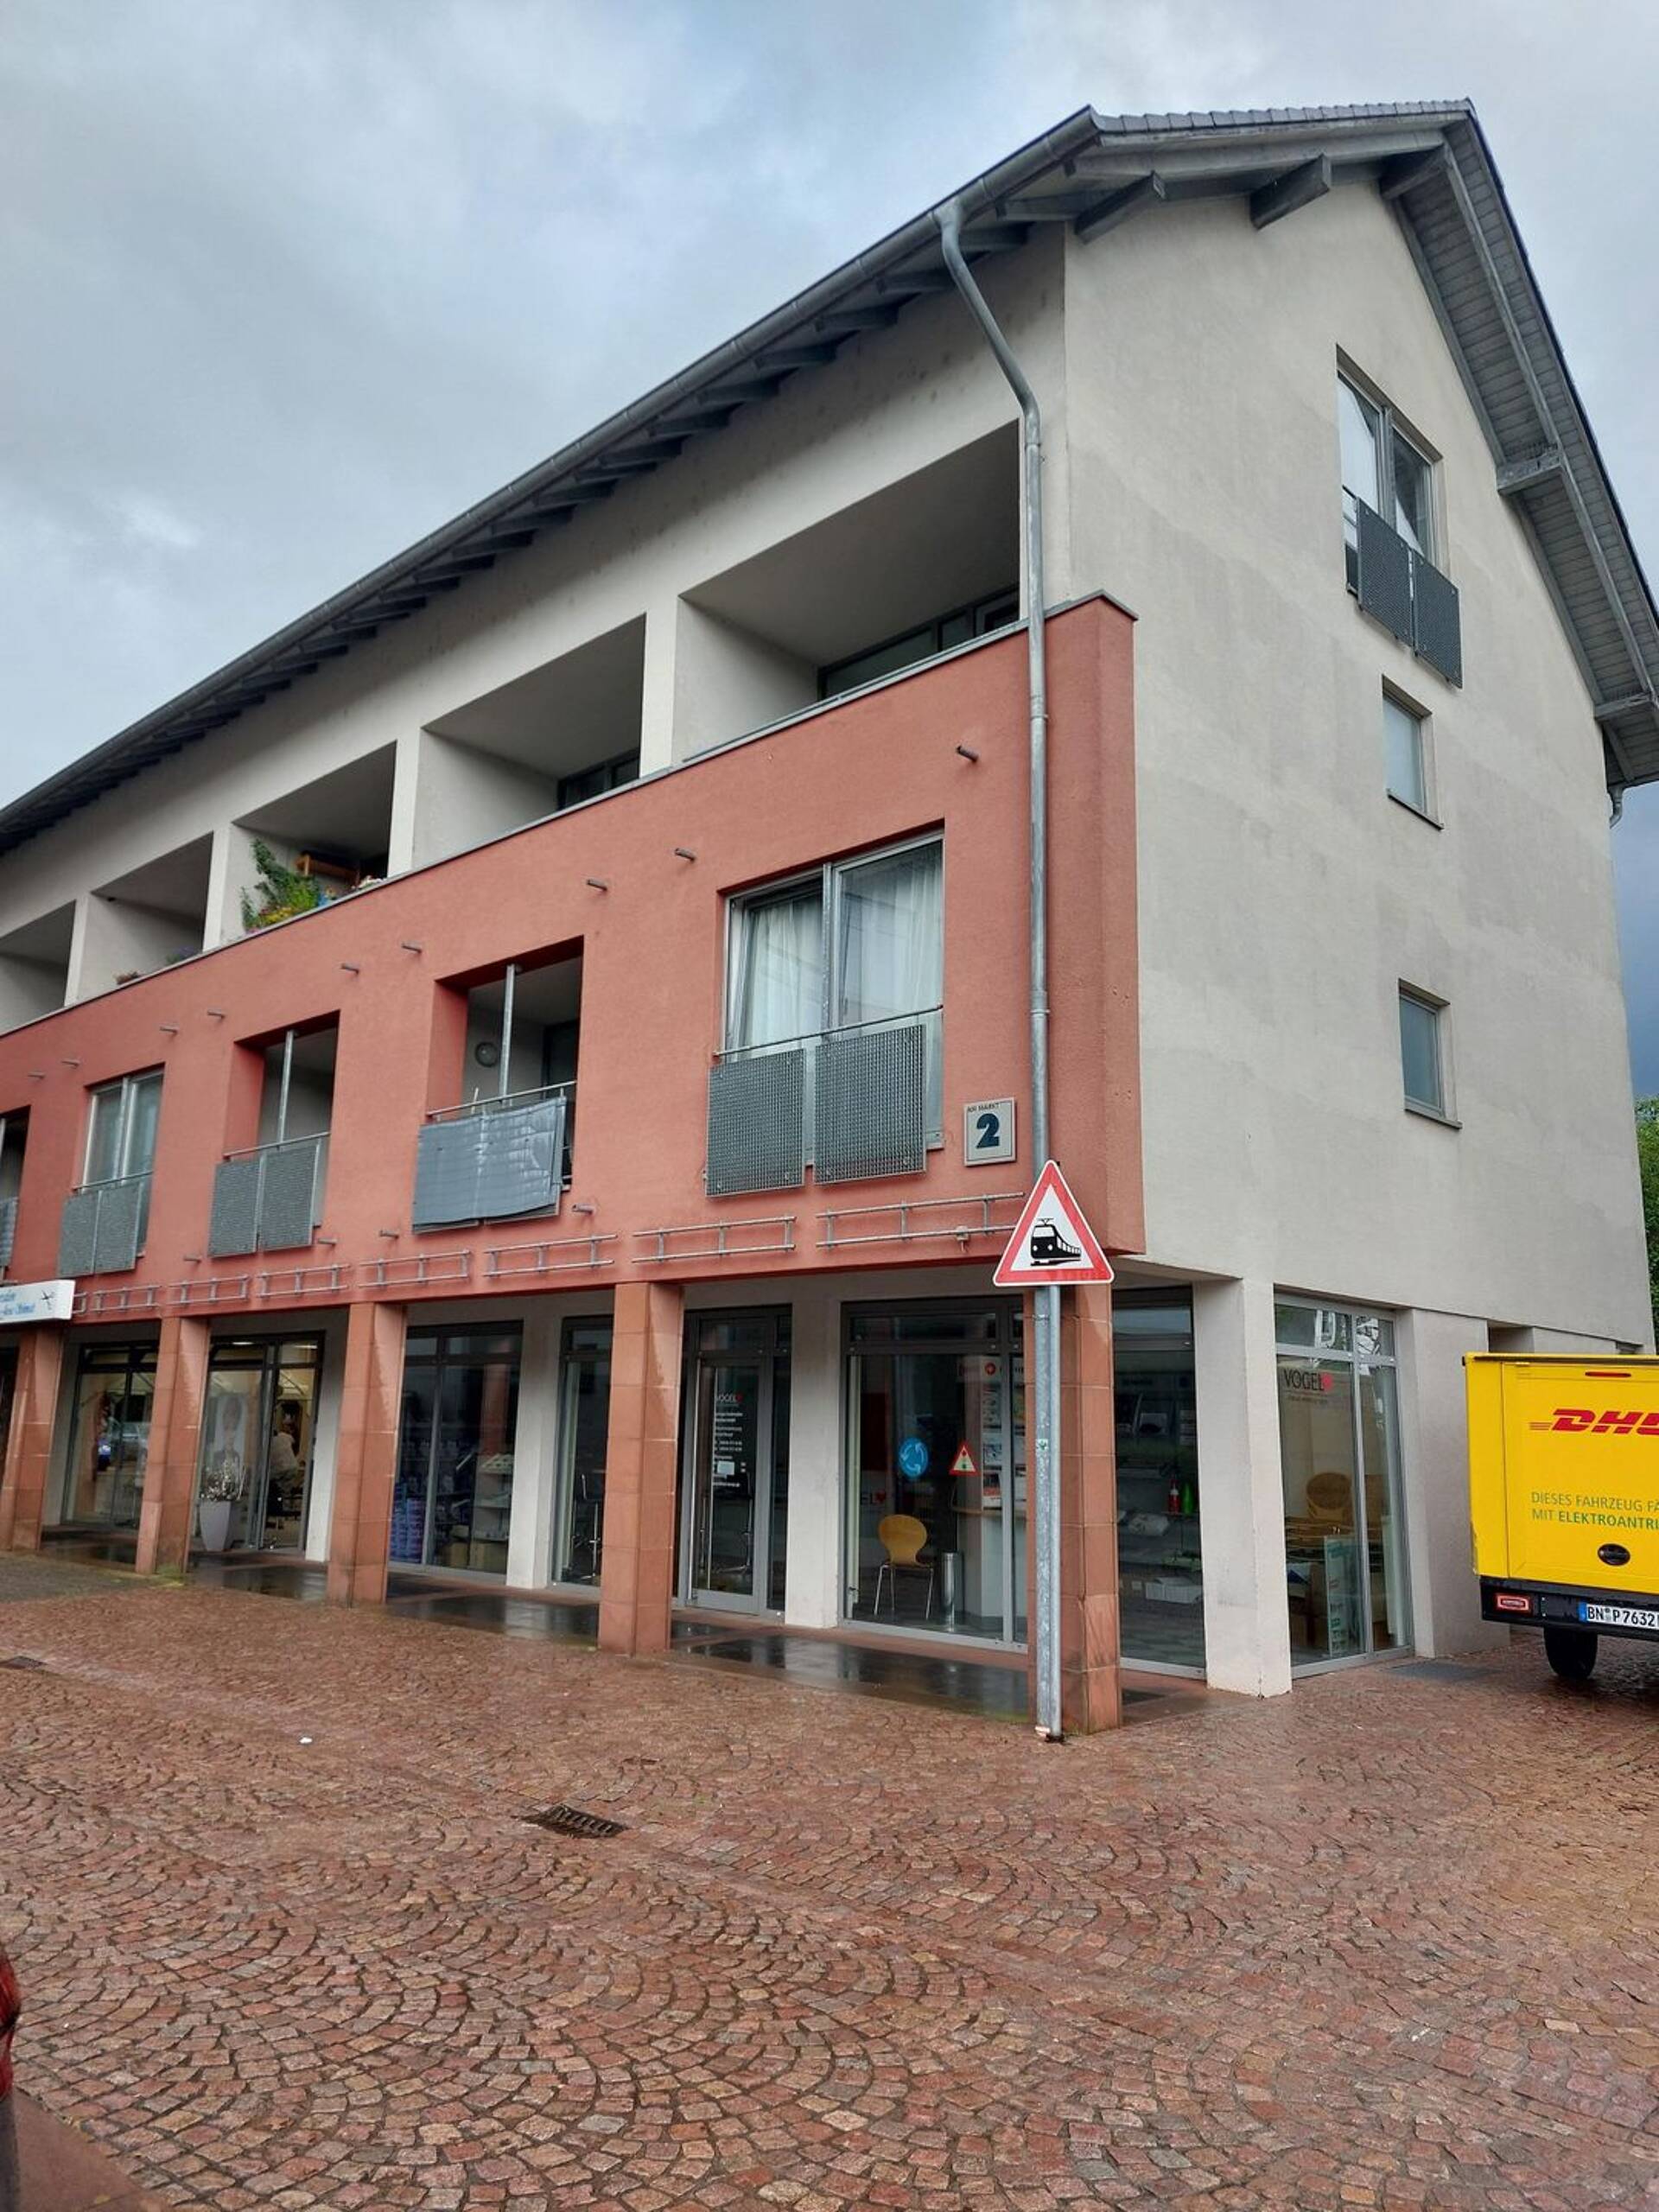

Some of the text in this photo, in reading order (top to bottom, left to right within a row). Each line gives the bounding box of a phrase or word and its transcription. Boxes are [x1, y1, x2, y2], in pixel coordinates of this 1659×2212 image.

[976, 1113, 1000, 1149] 2
[1284, 1369, 1325, 1391] VOGEL
[1531, 1491, 1573, 1507] DIESES
[1575, 1496, 1643, 1512] FAHRZEUG
[1532, 1510, 1554, 1521] MIT
